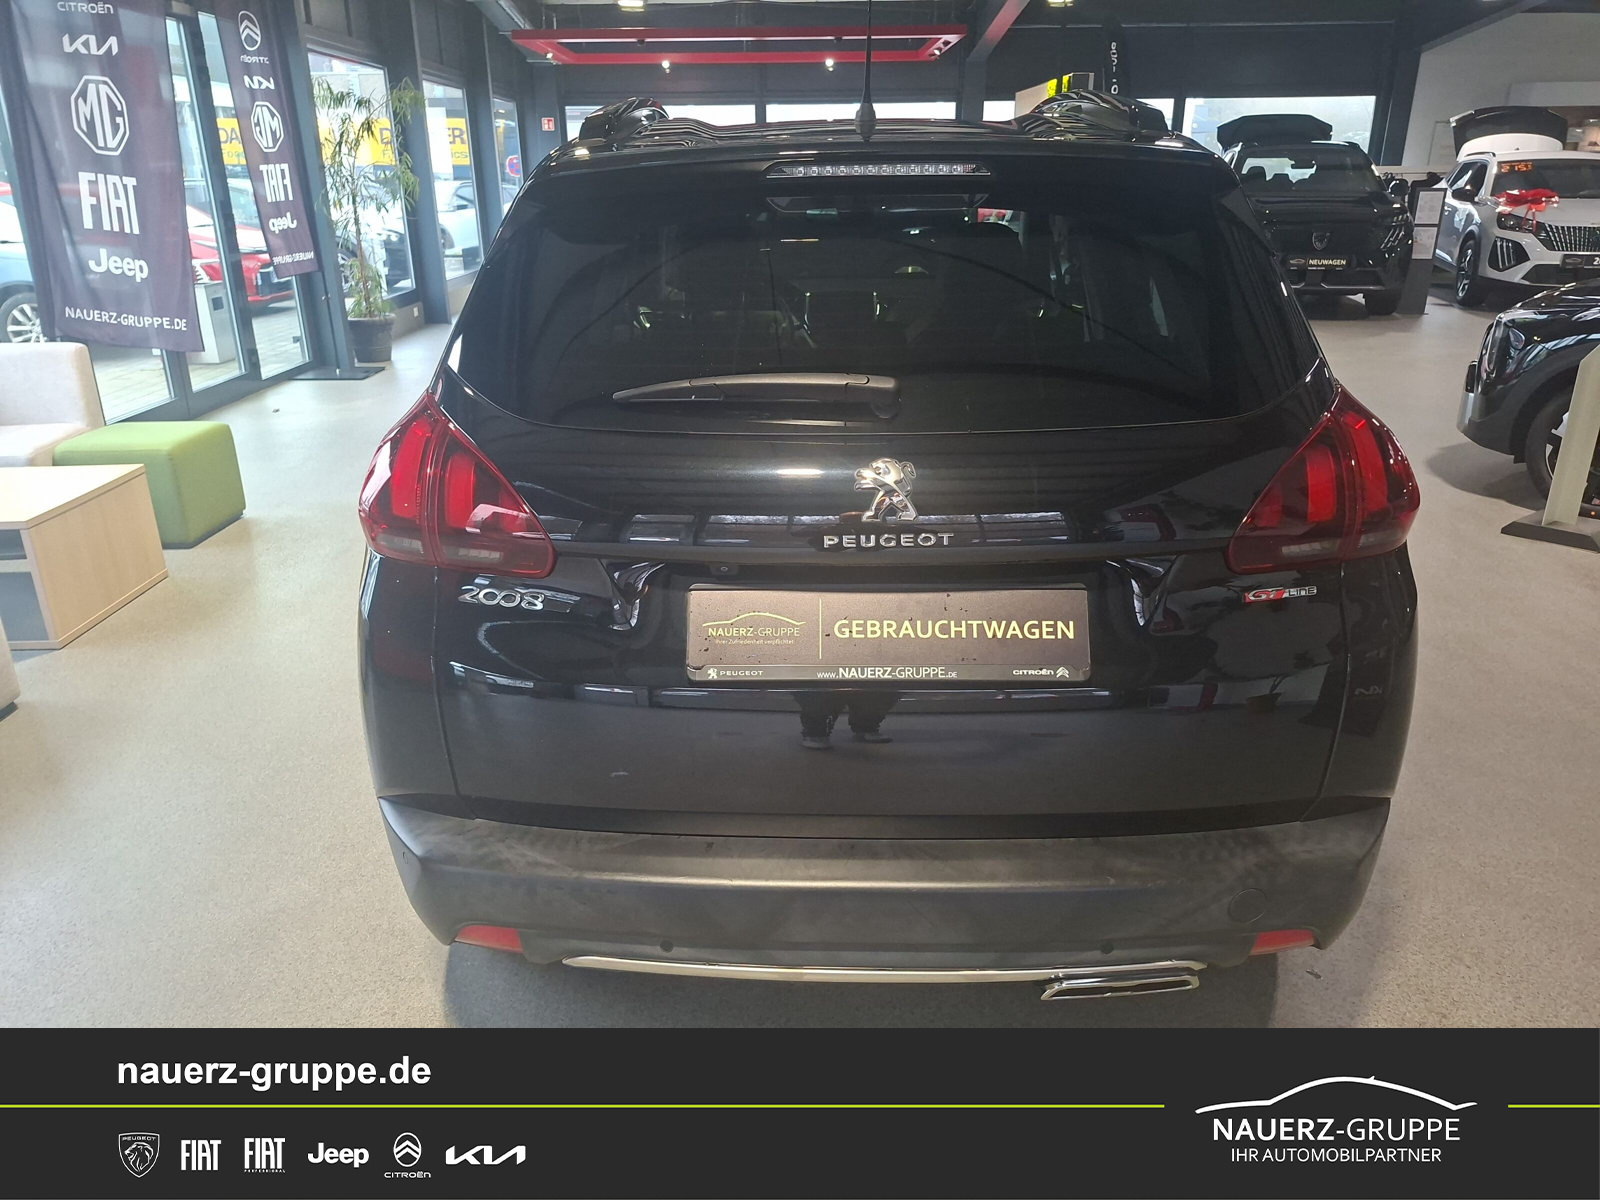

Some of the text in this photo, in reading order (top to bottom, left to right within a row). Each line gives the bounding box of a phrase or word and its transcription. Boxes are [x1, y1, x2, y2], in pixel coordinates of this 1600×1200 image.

[62, 33, 118, 56] KIA
[78, 83, 123, 149] MG
[78, 171, 140, 235] FIAT
[88, 248, 148, 282] Jeep
[65, 306, 187, 331] NAUERZ-GRUPPE.DE
[823, 532, 954, 549] PEUGEOT
[459, 585, 545, 611] 2008
[708, 627, 801, 637] NAUERZ-GRUPPE
[833, 619, 1074, 640] GEBRAUCHTWAGEN
